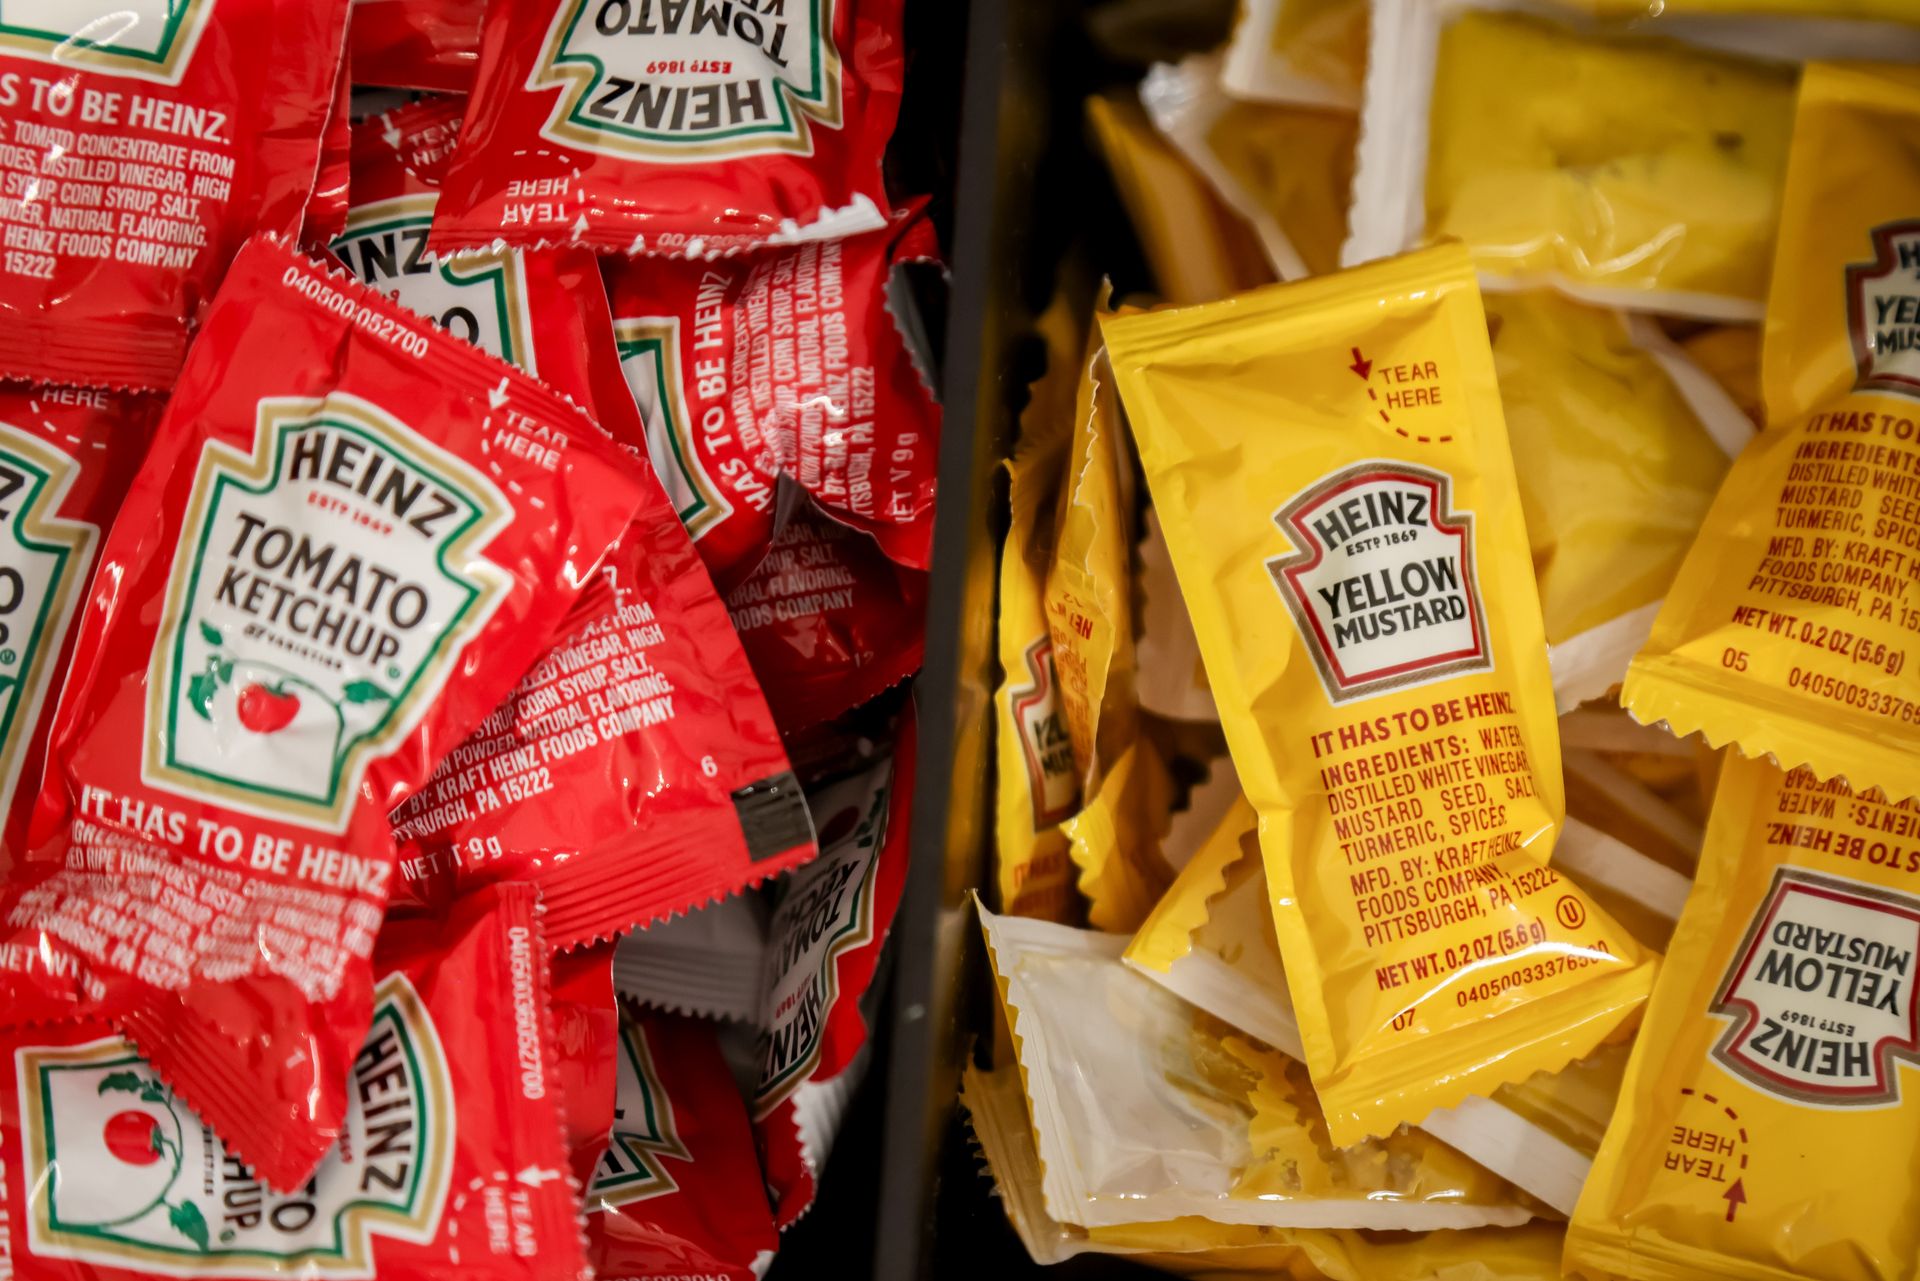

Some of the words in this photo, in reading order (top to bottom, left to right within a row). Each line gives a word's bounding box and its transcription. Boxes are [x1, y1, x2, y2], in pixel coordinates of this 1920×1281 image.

[596, 0, 789, 68] TOMATO
[647, 60, 685, 74] 1869
[29, 77, 74, 117] TO
[80, 89, 122, 125] BE
[128, 95, 231, 145] HEINZ.
[589, 76, 768, 131] HEINZ
[14, 119, 74, 149] TOMATO
[77, 133, 186, 169] CONCENTRATE
[189, 153, 235, 180] FROM
[60, 183, 101, 207] CORN
[105, 188, 156, 216] SYRUP,
[161, 198, 200, 223] SALT,
[118, 163, 188, 195] VINEGAR,
[192, 178, 230, 202] HIGH
[506, 178, 569, 197] HERE
[49, 208, 115, 233] NATURAL
[119, 217, 207, 247] FLAVORING.
[501, 203, 569, 223] TEAR
[4, 251, 56, 279] 15222
[5, 226, 55, 254] HEINZ
[58, 233, 111, 259] FOODS
[115, 239, 198, 269] COMPANY
[819, 240, 844, 309] COMPAN
[773, 338, 797, 381] CORN
[797, 315, 823, 386] NATURAL
[821, 311, 848, 370] FOODS
[696, 357, 727, 399] BE
[852, 366, 875, 419] 15222
[1377, 360, 1440, 385] TEAR
[42, 388, 109, 411] HERE
[1386, 386, 1443, 410] HERE
[702, 406, 732, 457] TO
[1828, 411, 1876, 433] HAS
[1881, 414, 1914, 441] TO
[494, 429, 562, 472] HERE
[1788, 462, 1869, 486] DISTILLED
[288, 431, 458, 539] HEINZ
[1780, 485, 1863, 509] MUSTARD
[1312, 490, 1430, 552] HEINZ
[1384, 529, 1418, 547] 1869
[1776, 507, 1865, 536] TURMERIC,
[228, 511, 429, 630] TOMATO
[1767, 536, 1806, 557] MFD.
[1812, 537, 1840, 559] BY:
[1843, 541, 1906, 573] KRAFT
[776, 588, 853, 621] COMPANY
[1317, 556, 1459, 620] YELLOW
[1748, 575, 1863, 617] PITTSBURGH,
[1869, 597, 1893, 623] PA
[1757, 557, 1817, 582] FOODS
[1820, 562, 1909, 605] COMPANY,
[215, 566, 400, 667] KETCHUP
[1333, 594, 1466, 649] MUSTARD
[1731, 605, 1769, 629] NET
[1768, 612, 1798, 640] WT.
[1800, 621, 1828, 648] 0.2
[1828, 629, 1854, 655] OZ
[556, 632, 630, 675] VINEGAR,
[625, 623, 666, 650] HIGH
[518, 686, 561, 720] CORN
[611, 652, 654, 682] SALT,
[1722, 647, 1750, 672] 05
[1789, 666, 1920, 725] 040500333765
[521, 701, 590, 743] NATURAL
[1311, 730, 1334, 759] IT
[1338, 716, 1391, 750] HAS
[1392, 708, 1430, 736] TO
[1431, 698, 1465, 727] BE
[435, 763, 488, 803] KRAFT
[489, 744, 540, 782] HEINZ
[542, 726, 598, 763] FOODS
[599, 695, 675, 743] COMPANY
[701, 755, 718, 778] 6
[1320, 734, 1470, 791] INGREDIENTS:
[475, 786, 501, 814] PA
[500, 767, 554, 804] 15222
[1328, 773, 1416, 816] DISTILLED
[1417, 758, 1475, 790] WHITE
[81, 785, 112, 818] IT
[120, 796, 186, 844] HAS
[197, 820, 243, 861] TO
[250, 833, 294, 875] BE
[1334, 797, 1424, 841] MUSTARD
[1440, 782, 1494, 812] SEED,
[1340, 820, 1446, 867] TURMERIC,
[1767, 823, 1833, 852] HEINZ.
[1834, 833, 1866, 861] BE
[1868, 842, 1901, 869] TO
[400, 853, 440, 882] NET
[1350, 865, 1398, 897] MFD.
[1399, 857, 1432, 883] BY:
[1433, 840, 1487, 873] KRAFT
[1487, 831, 1523, 858] HEINZ
[1356, 887, 1421, 922] FOODS
[1423, 862, 1511, 904] COMPANY,
[1363, 895, 1487, 948] PITTSBURGH,
[1489, 884, 1513, 911] PA
[1511, 866, 1559, 899] 15222
[1375, 960, 1411, 991] NET
[1411, 952, 1445, 982] WT.
[1445, 944, 1473, 970] 0.2
[1472, 934, 1497, 961] OZ
[1773, 920, 1912, 976] MUSTARD
[1754, 948, 1901, 1017] YELLOW
[1392, 1007, 1417, 1032] 07
[1780, 1010, 1815, 1028] 1869
[1750, 1017, 1870, 1077] HEINZ
[355, 1029, 413, 1194] HEINZ
[1670, 1125, 1735, 1157] HERE
[1664, 1150, 1727, 1183] TEAR
[509, 1190, 537, 1257] TEAR
